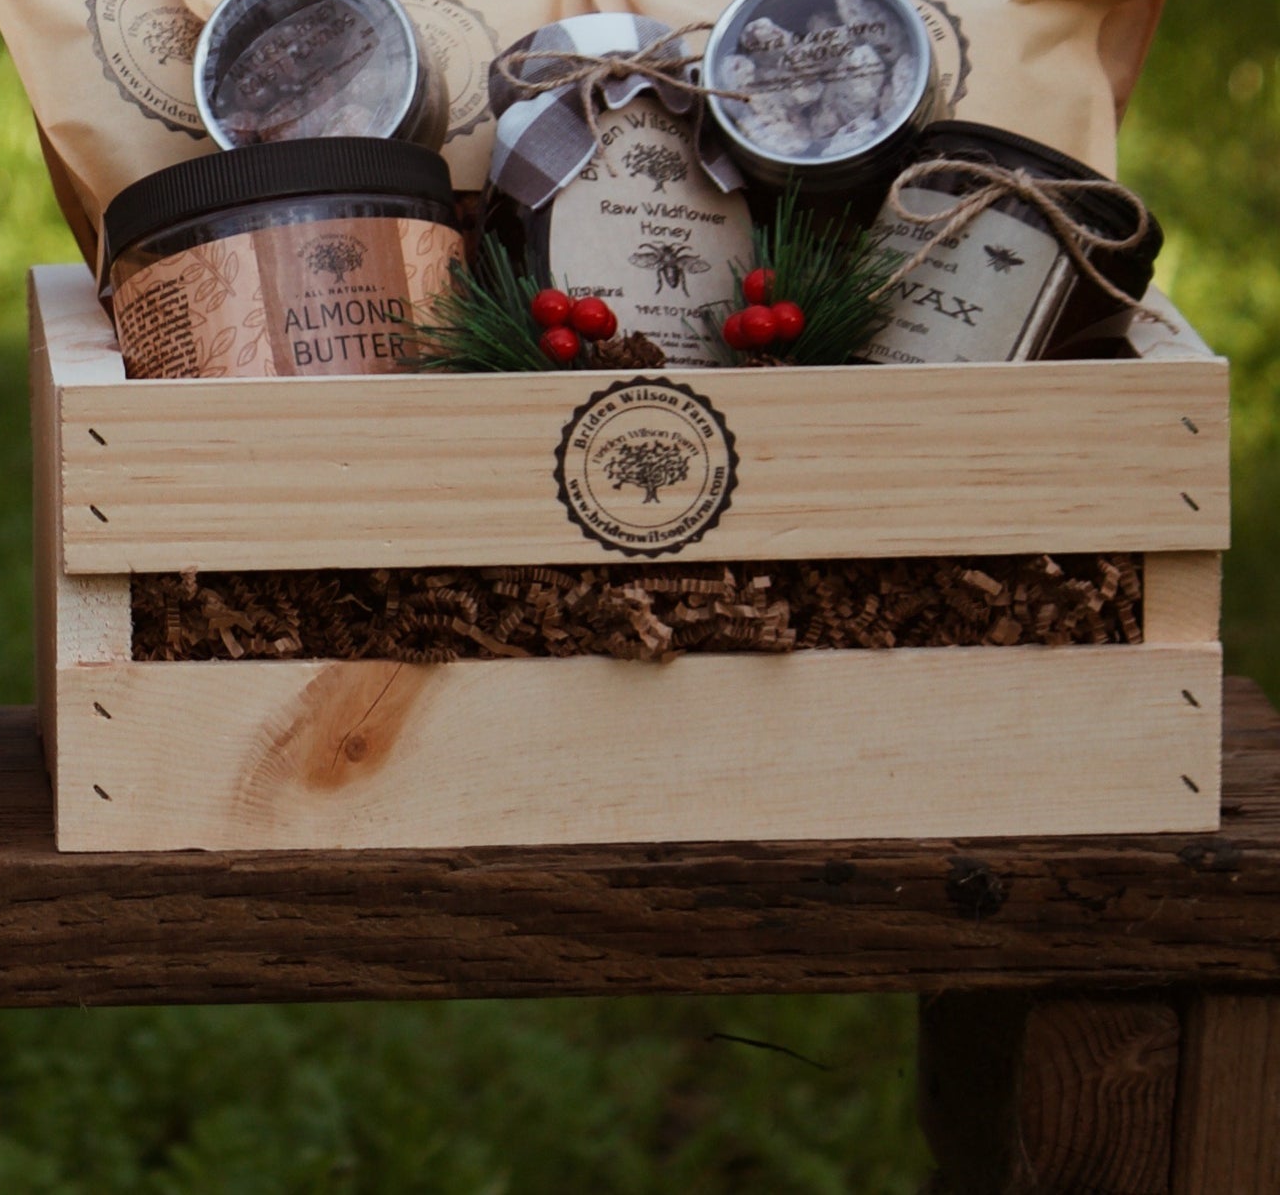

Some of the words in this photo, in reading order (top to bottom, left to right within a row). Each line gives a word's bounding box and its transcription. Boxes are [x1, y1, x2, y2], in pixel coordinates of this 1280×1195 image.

[581, 124, 624, 181] Bren
[623, 110, 689, 145] Wilson
[600, 199, 638, 215] Raw
[642, 202, 728, 226] Wildflower
[640, 221, 692, 242] Honey
[304, 290, 323, 299] ALL
[328, 285, 377, 295] NATURAL
[285, 299, 405, 334] ALMOND
[293, 332, 406, 367] BUTTER
[574, 402, 616, 451] Briden
[619, 388, 679, 407] Wilson
[680, 400, 715, 439] Farm
[568, 465, 726, 544] www.bridenwilsonfarm.com
